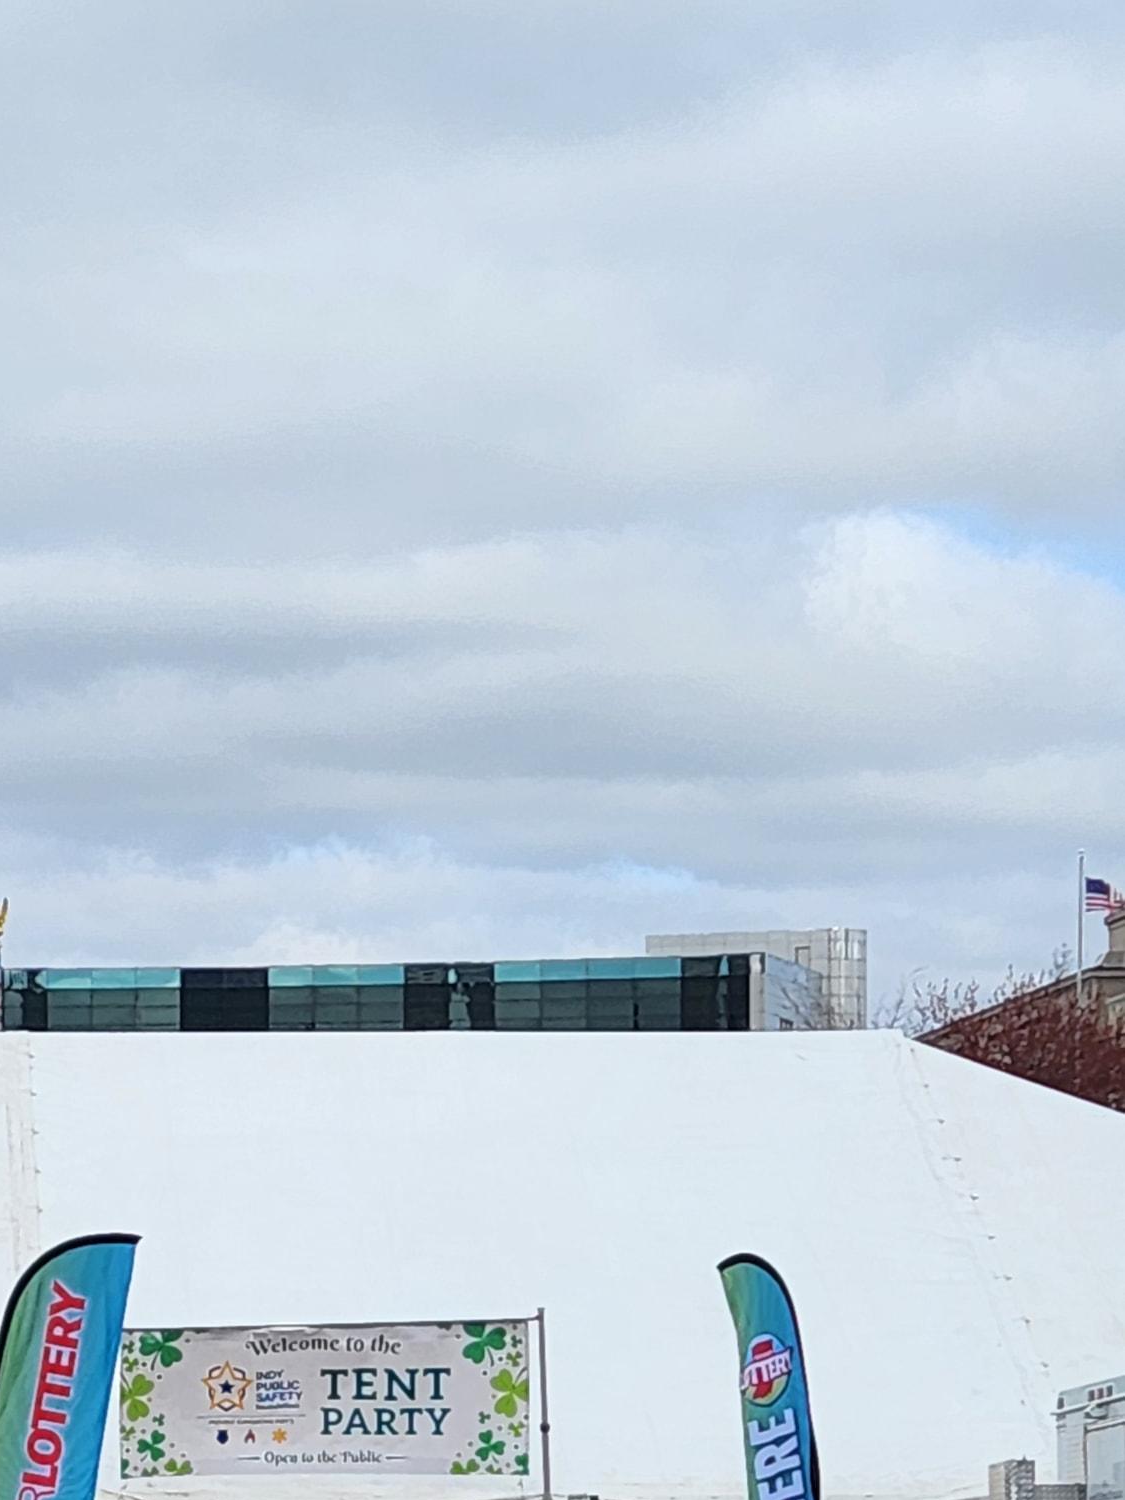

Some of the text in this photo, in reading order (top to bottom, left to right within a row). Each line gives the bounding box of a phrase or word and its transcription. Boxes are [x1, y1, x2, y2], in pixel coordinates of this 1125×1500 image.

[245, 1333, 402, 1356] Welcome to the
[256, 1369, 284, 1380] INDY
[256, 1380, 300, 1391] PUBLIC
[320, 1367, 451, 1401] TENT
[256, 1391, 303, 1403] SAFETY
[320, 1406, 451, 1435] PARTY
[264, 1450, 382, 1467] Open to the Public
